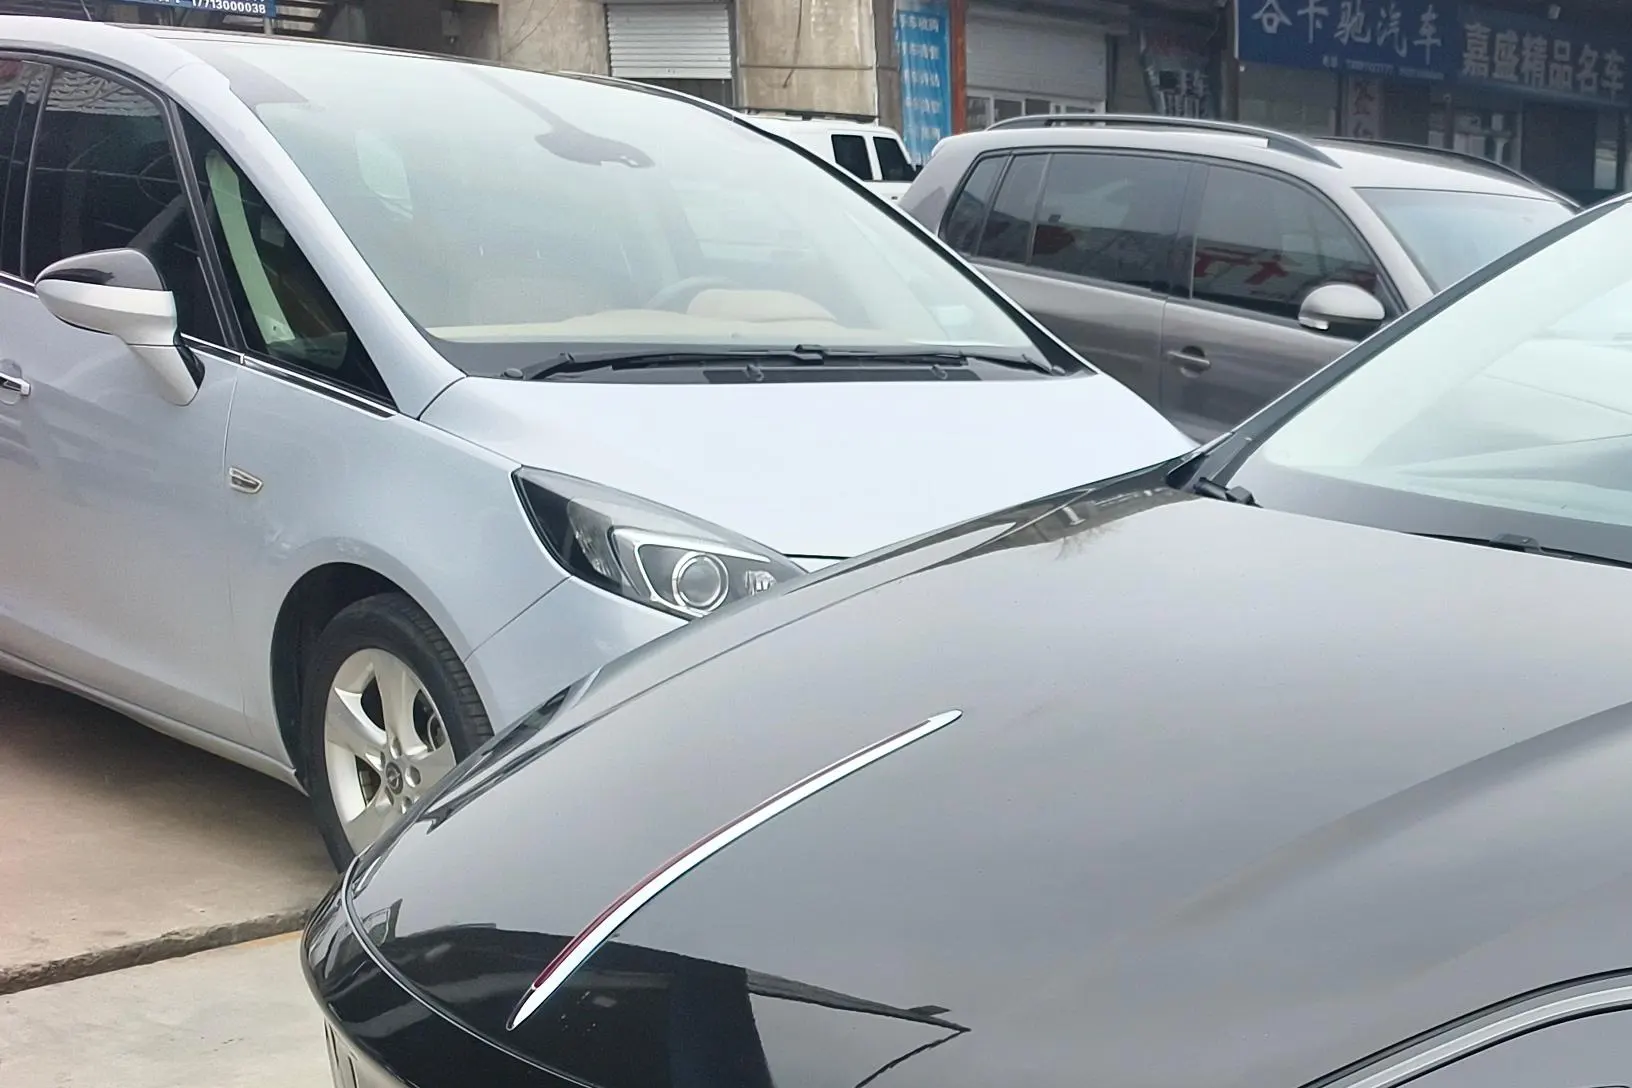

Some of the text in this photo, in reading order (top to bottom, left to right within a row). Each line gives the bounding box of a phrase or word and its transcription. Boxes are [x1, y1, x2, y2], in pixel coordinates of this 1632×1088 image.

[1461, 23, 1627, 103] 嘉盛精品名车
